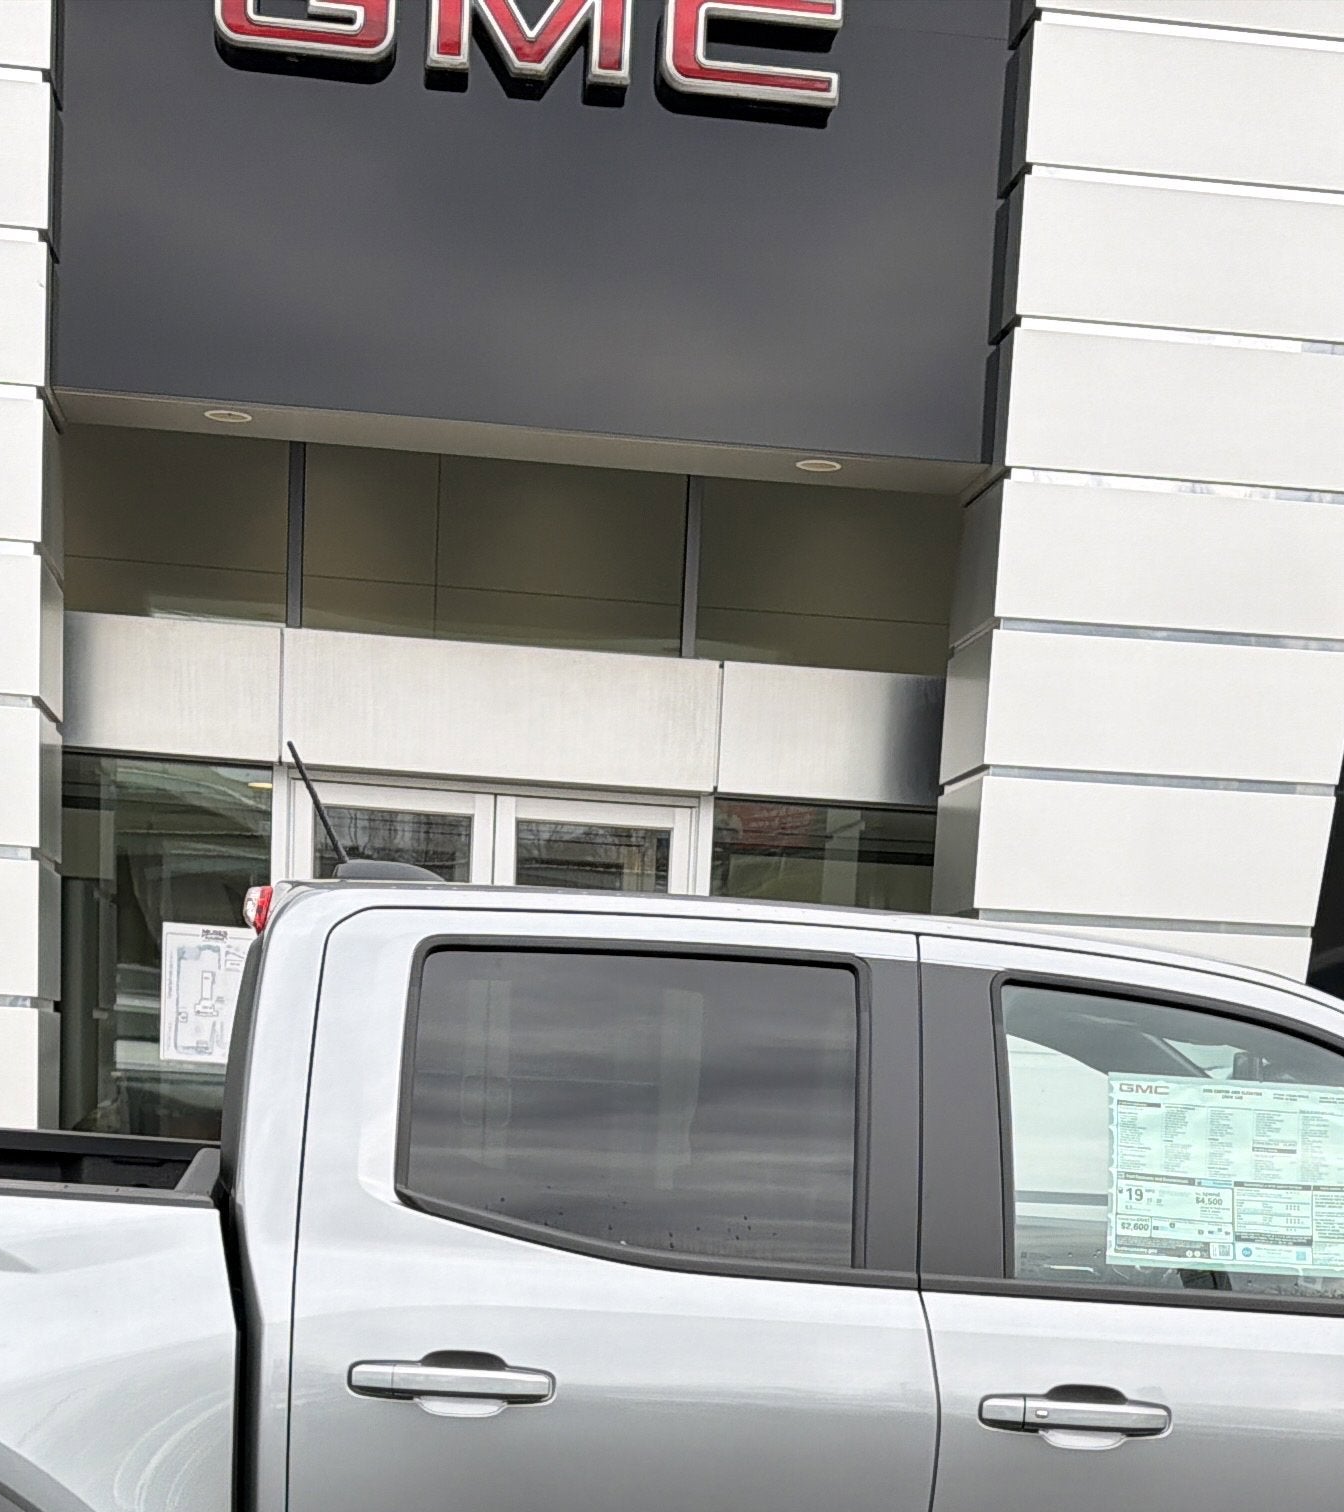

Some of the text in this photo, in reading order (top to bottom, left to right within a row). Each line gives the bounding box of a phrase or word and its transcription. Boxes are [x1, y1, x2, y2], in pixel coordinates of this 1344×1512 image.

[1119, 1082, 1170, 1095] GMC
[1125, 1187, 1144, 1202] 19
[1195, 1196, 1223, 1206] $4,500
[1120, 1222, 1150, 1231] $2,600
